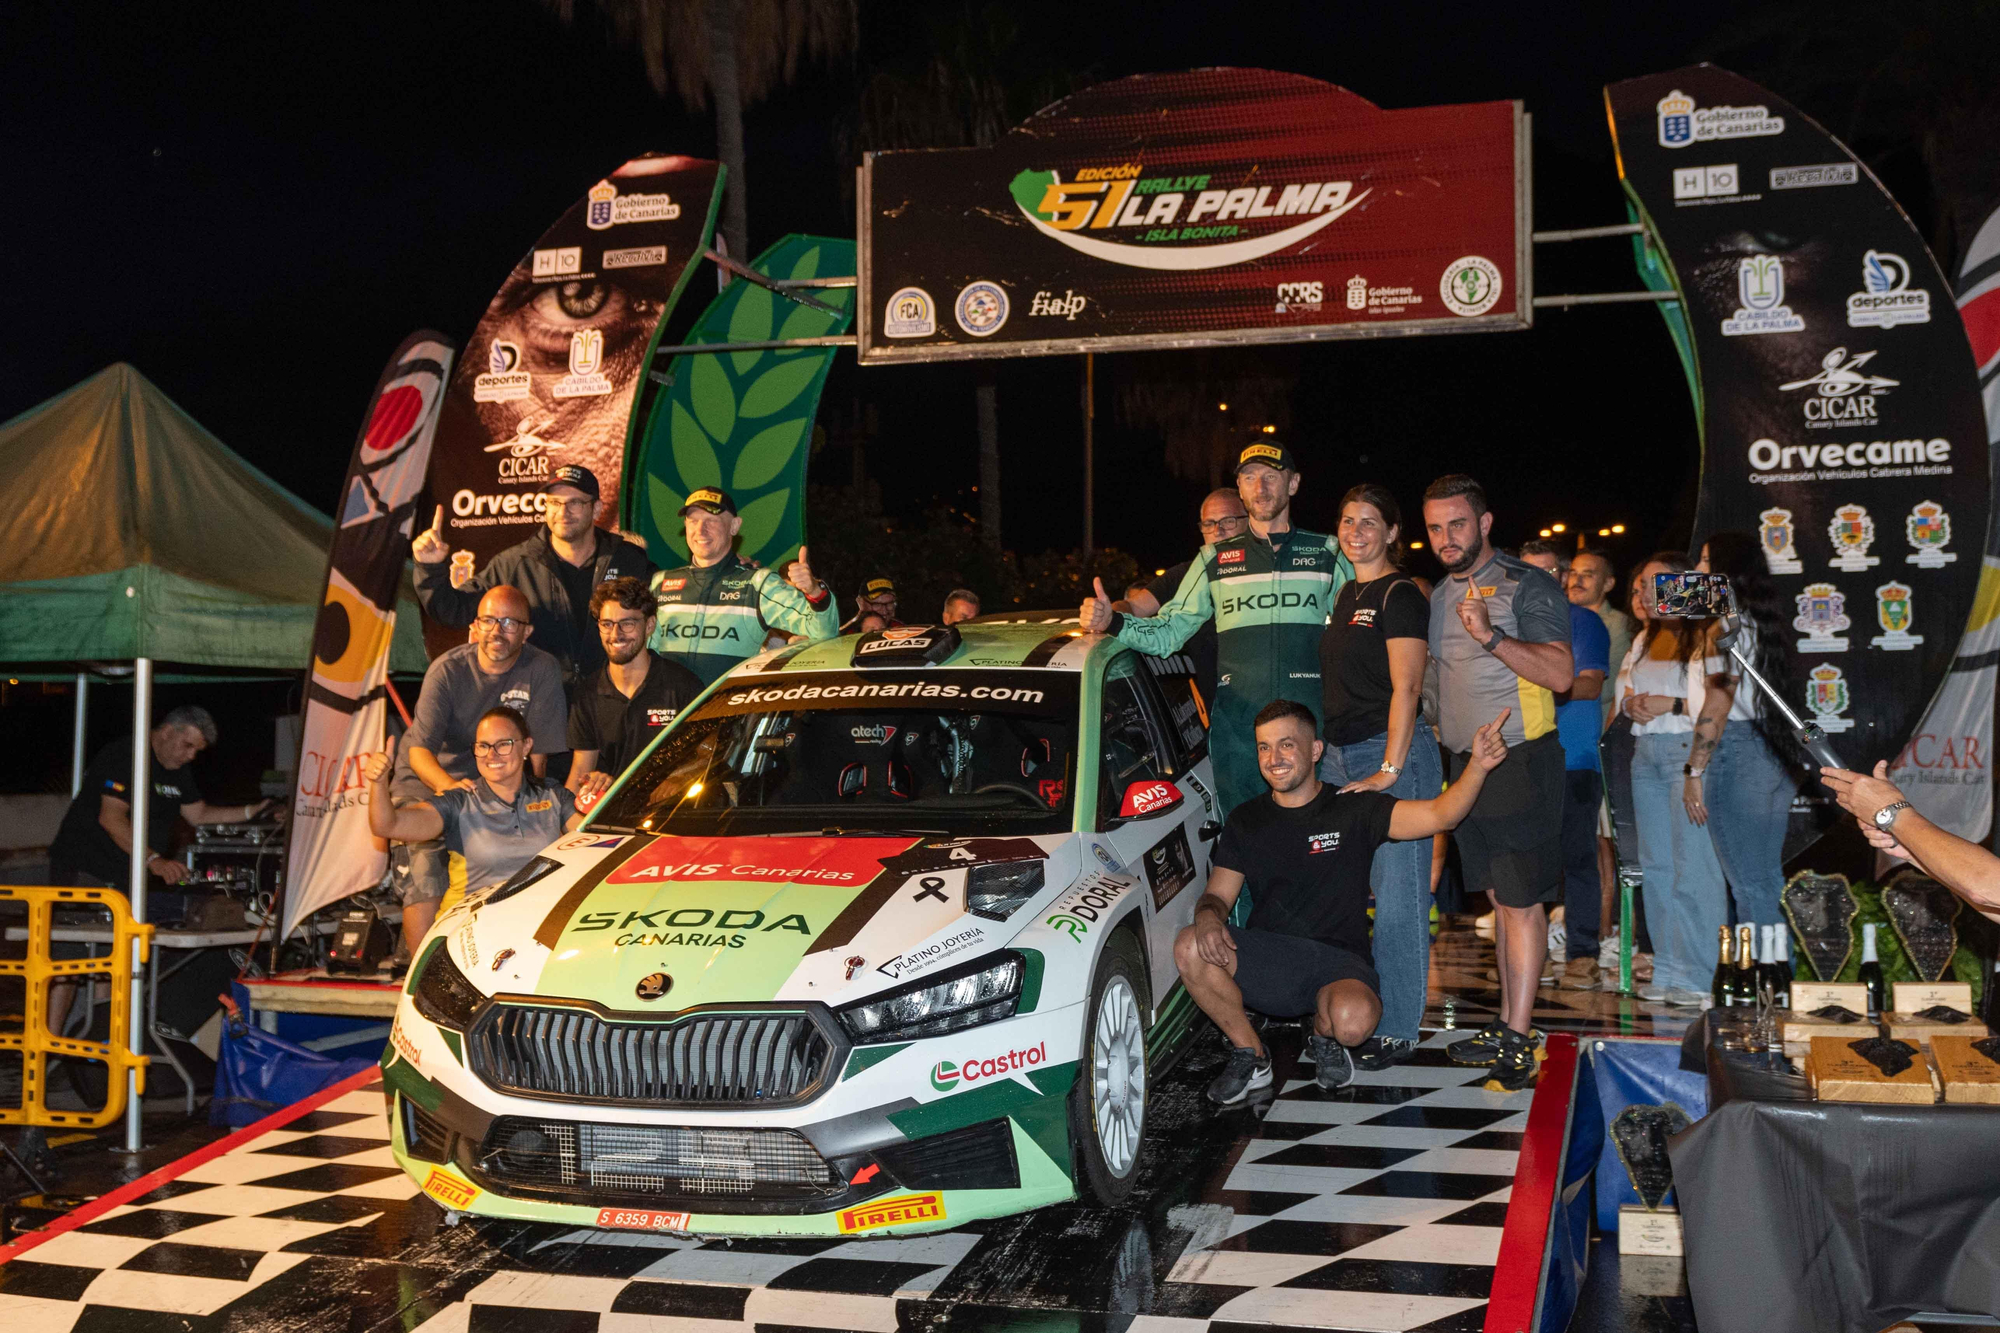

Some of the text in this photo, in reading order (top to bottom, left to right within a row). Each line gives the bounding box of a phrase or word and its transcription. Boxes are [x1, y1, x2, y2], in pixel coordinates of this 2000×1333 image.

[1697, 109, 1764, 123] Gobierno
[1697, 120, 1779, 137] de Canarias
[1075, 163, 1143, 181] EDICIÓN
[1135, 175, 1211, 194] RALLYE
[616, 197, 666, 209] Gobierno
[1118, 181, 1353, 226] LA PALMA
[615, 206, 676, 220] de Canarias
[1145, 224, 1239, 241] ISLA BONITA
[1368, 287, 1413, 297] Gobierno
[1029, 290, 1086, 320] fialp
[1368, 295, 1422, 306] de Canarias
[1852, 294, 1925, 312] deportes
[900, 303, 919, 319] FCA
[1737, 309, 1788, 321] CABILDO
[1725, 319, 1801, 332] DE LA PALMA
[478, 375, 528, 388] deportes
[565, 376, 601, 386] CABILDO
[555, 387, 567, 395] DE
[582, 384, 609, 393] PALMA
[1804, 395, 1878, 421] CICAR
[1805, 418, 1878, 429] Canary Islands Car
[1748, 438, 1951, 471] Orvecame
[499, 456, 549, 477] CICAR
[498, 476, 517, 485] Canary
[1748, 465, 1953, 485] Organización Vehículos Cabrera Medina
[452, 488, 547, 516] Orveca
[450, 518, 497, 528] Organización
[498, 515, 533, 525] Vehículos
[1221, 551, 1241, 560] AVIS
[1292, 558, 1316, 566] DAG
[720, 591, 740, 600] DAG
[867, 639, 926, 651] LUCAS
[728, 681, 1044, 706] skodacanarias.com
[851, 724, 884, 737] atech
[1133, 784, 1168, 808] AVIS
[1139, 797, 1172, 813] Canarias
[1308, 832, 1340, 843] SPORTS
[949, 848, 977, 861] 4
[630, 863, 855, 881] AVIS Canarias
[1070, 877, 1131, 923] DORAL
[614, 933, 747, 949] CANARIAS
[894, 928, 984, 971] PLATINO JOYERÍA
[907, 964, 924, 975] Desde
[936, 947, 961, 960] cómplices
[973, 937, 984, 945] vida
[395, 1027, 422, 1067] Castrol
[962, 1041, 1047, 1081] Castrol
[424, 1170, 477, 1207] PIRELLI
[601, 1211, 680, 1228] S 6359 BCM
[843, 1196, 939, 1231] PIRELLI
